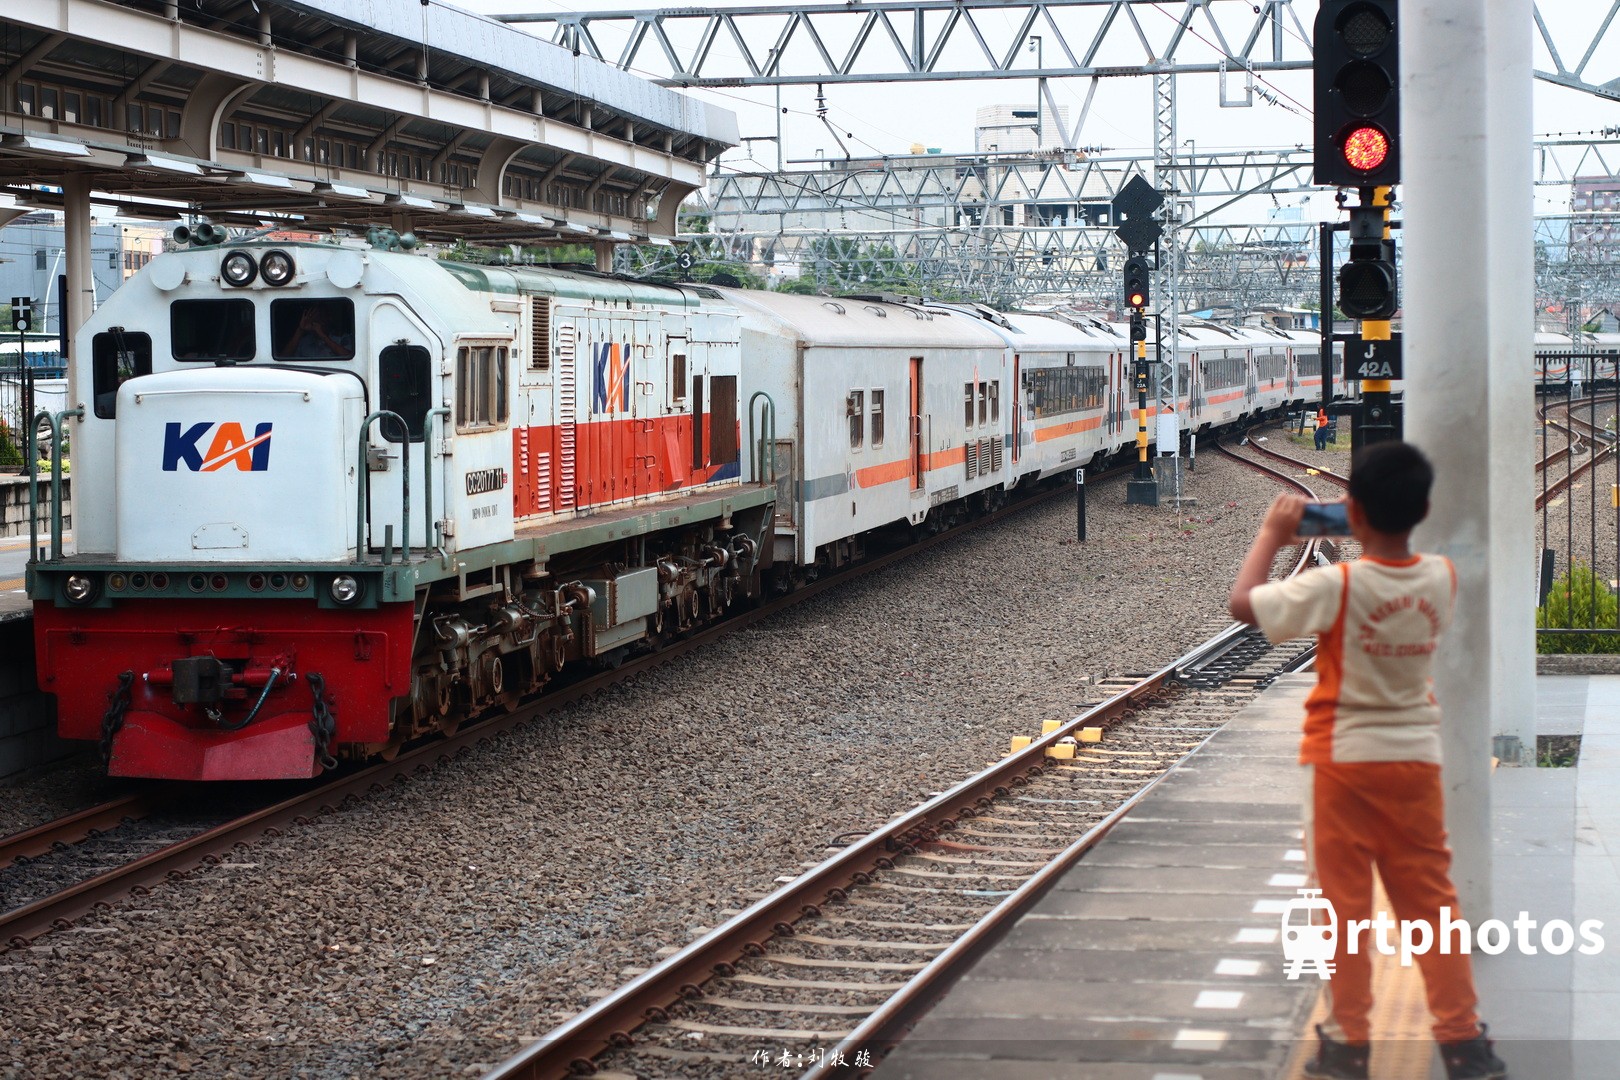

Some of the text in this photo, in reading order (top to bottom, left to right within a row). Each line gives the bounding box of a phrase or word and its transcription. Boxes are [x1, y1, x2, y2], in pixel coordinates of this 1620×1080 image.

[680, 252, 691, 269] 3
[1364, 343, 1377, 359] J
[1357, 361, 1394, 377] 42A
[593, 342, 630, 414] KAI
[162, 422, 273, 472] KAI
[1077, 470, 1083, 483] 6
